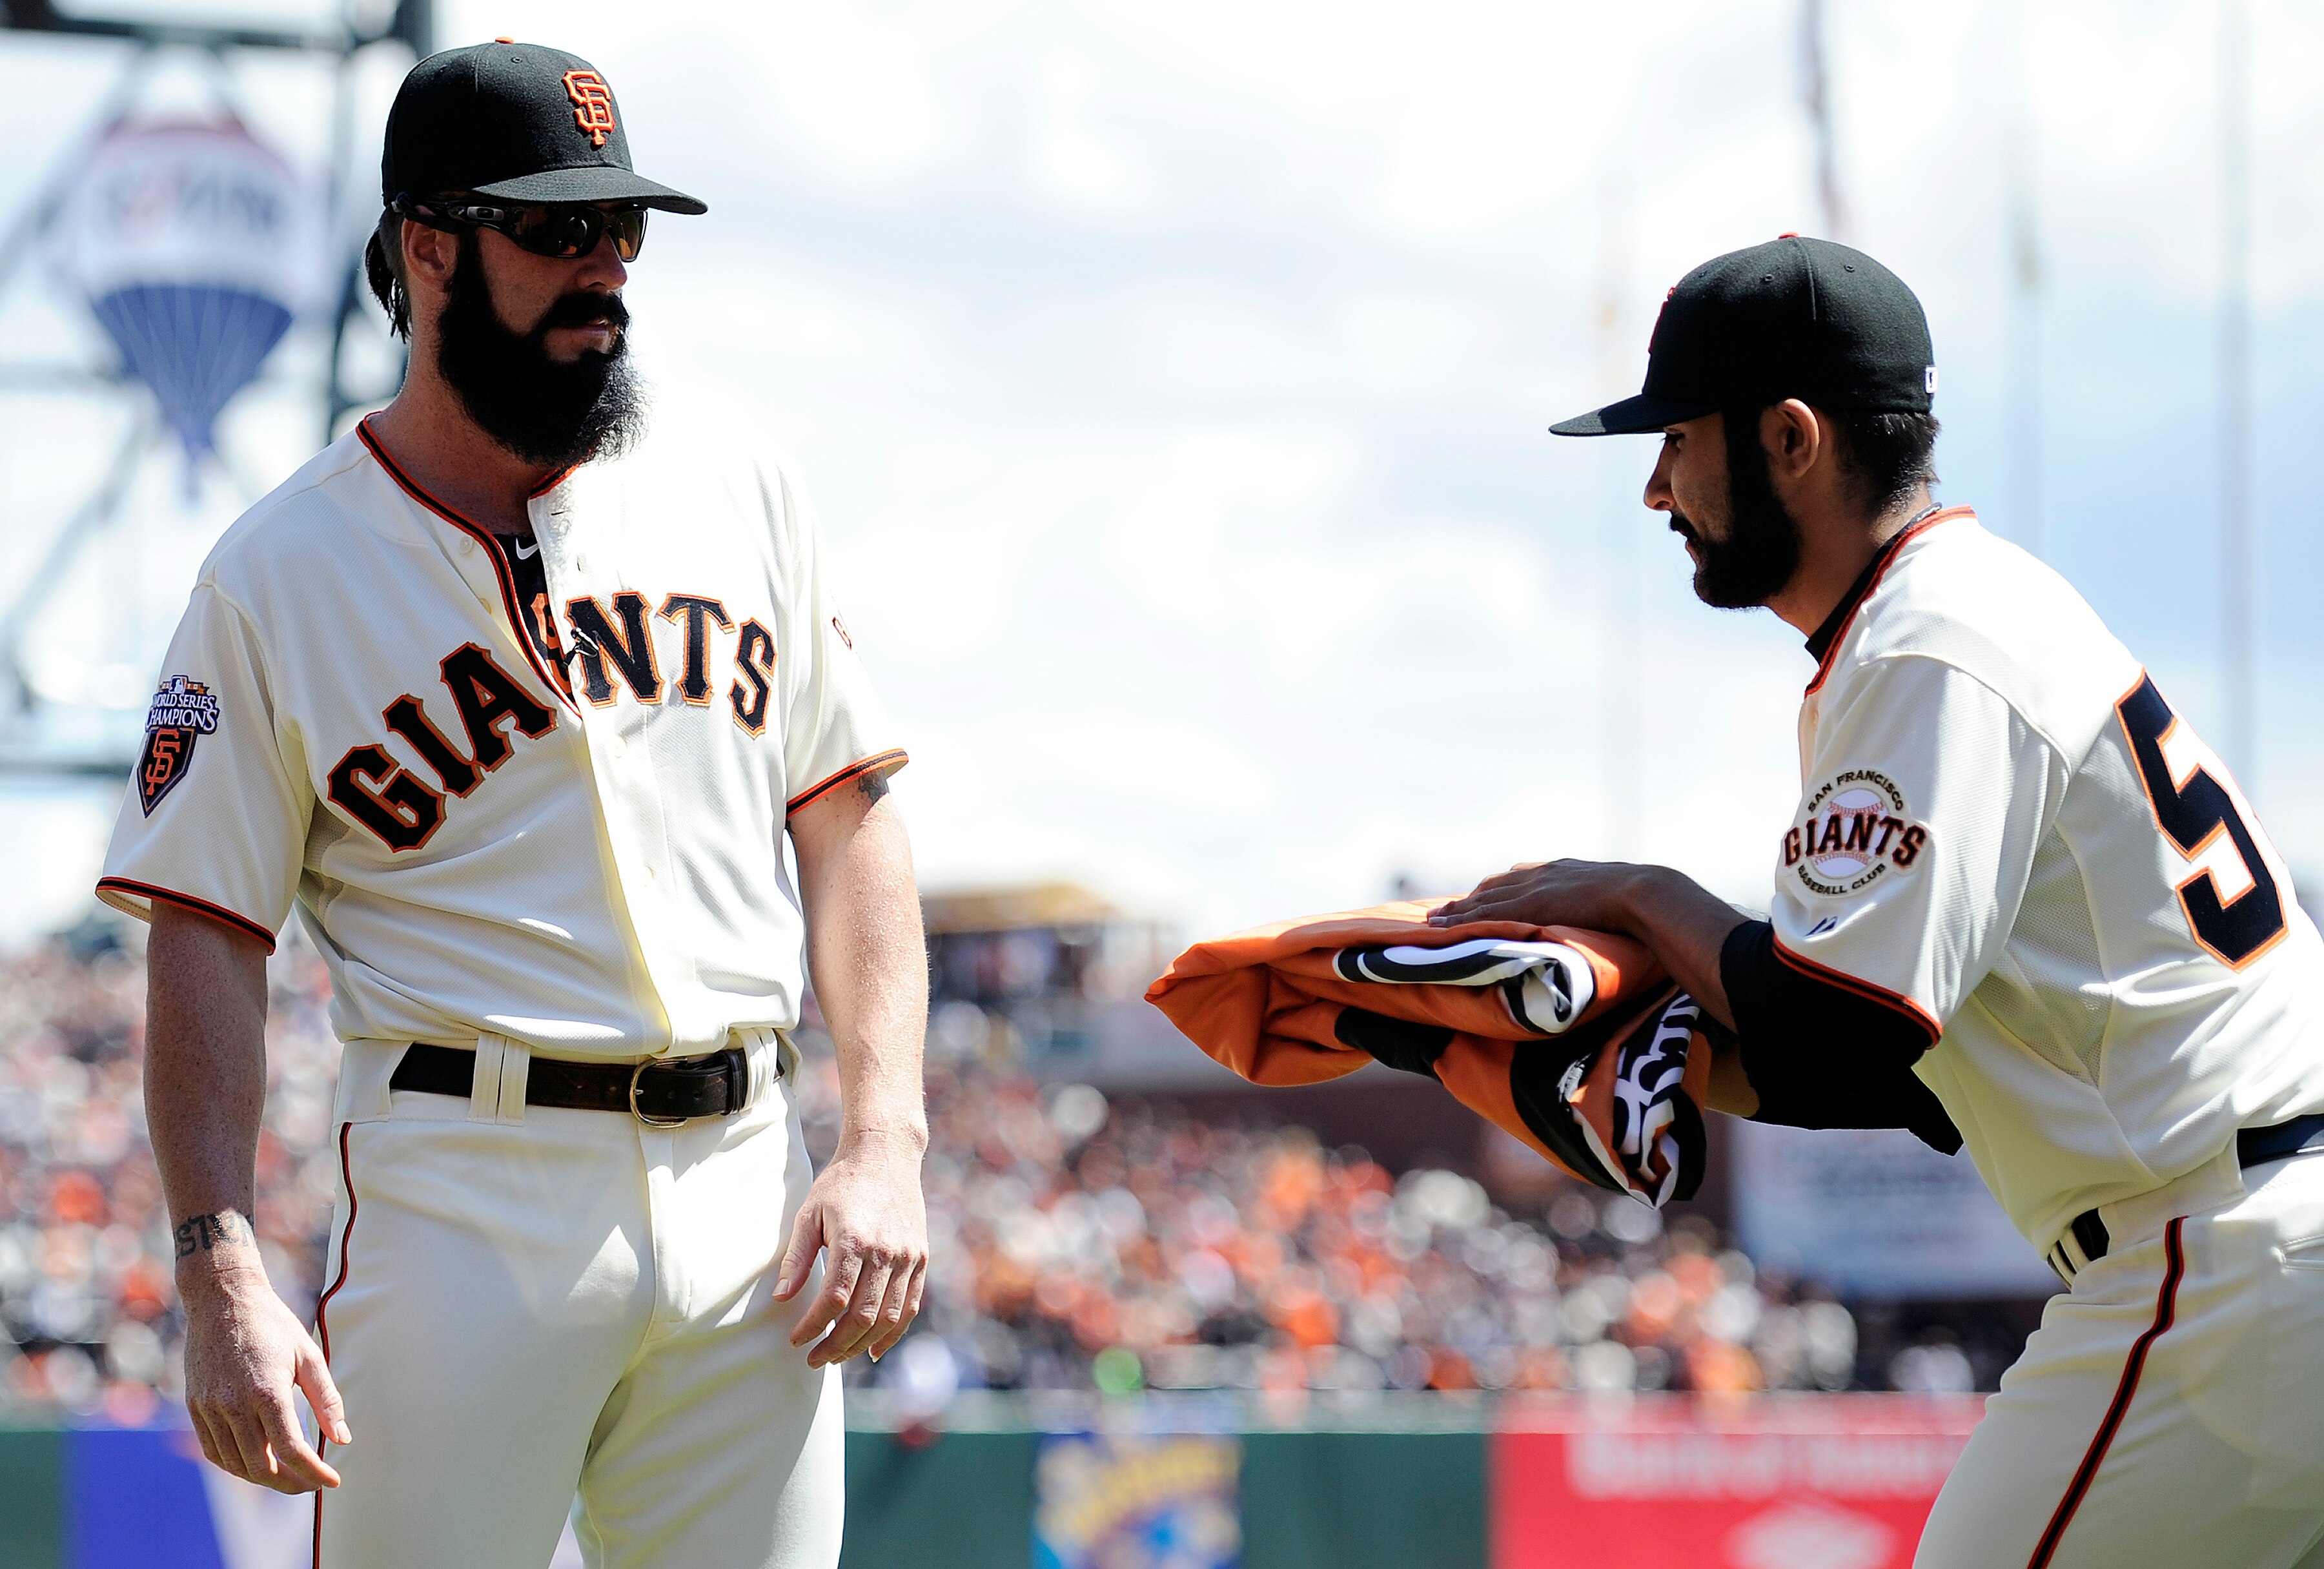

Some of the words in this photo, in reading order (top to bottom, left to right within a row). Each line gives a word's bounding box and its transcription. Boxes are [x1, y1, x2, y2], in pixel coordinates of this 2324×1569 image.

[146, 708, 218, 731] HAMPIONS
[178, 694, 215, 710] SERIES
[327, 590, 777, 854] GIANTS
[1808, 783, 1832, 812] SAN
[1837, 770, 1903, 811] FRANCISCO
[1784, 812, 1927, 869] GIANTS
[1798, 863, 1847, 894] BASEBALL
[1851, 863, 1886, 889] CLUB
